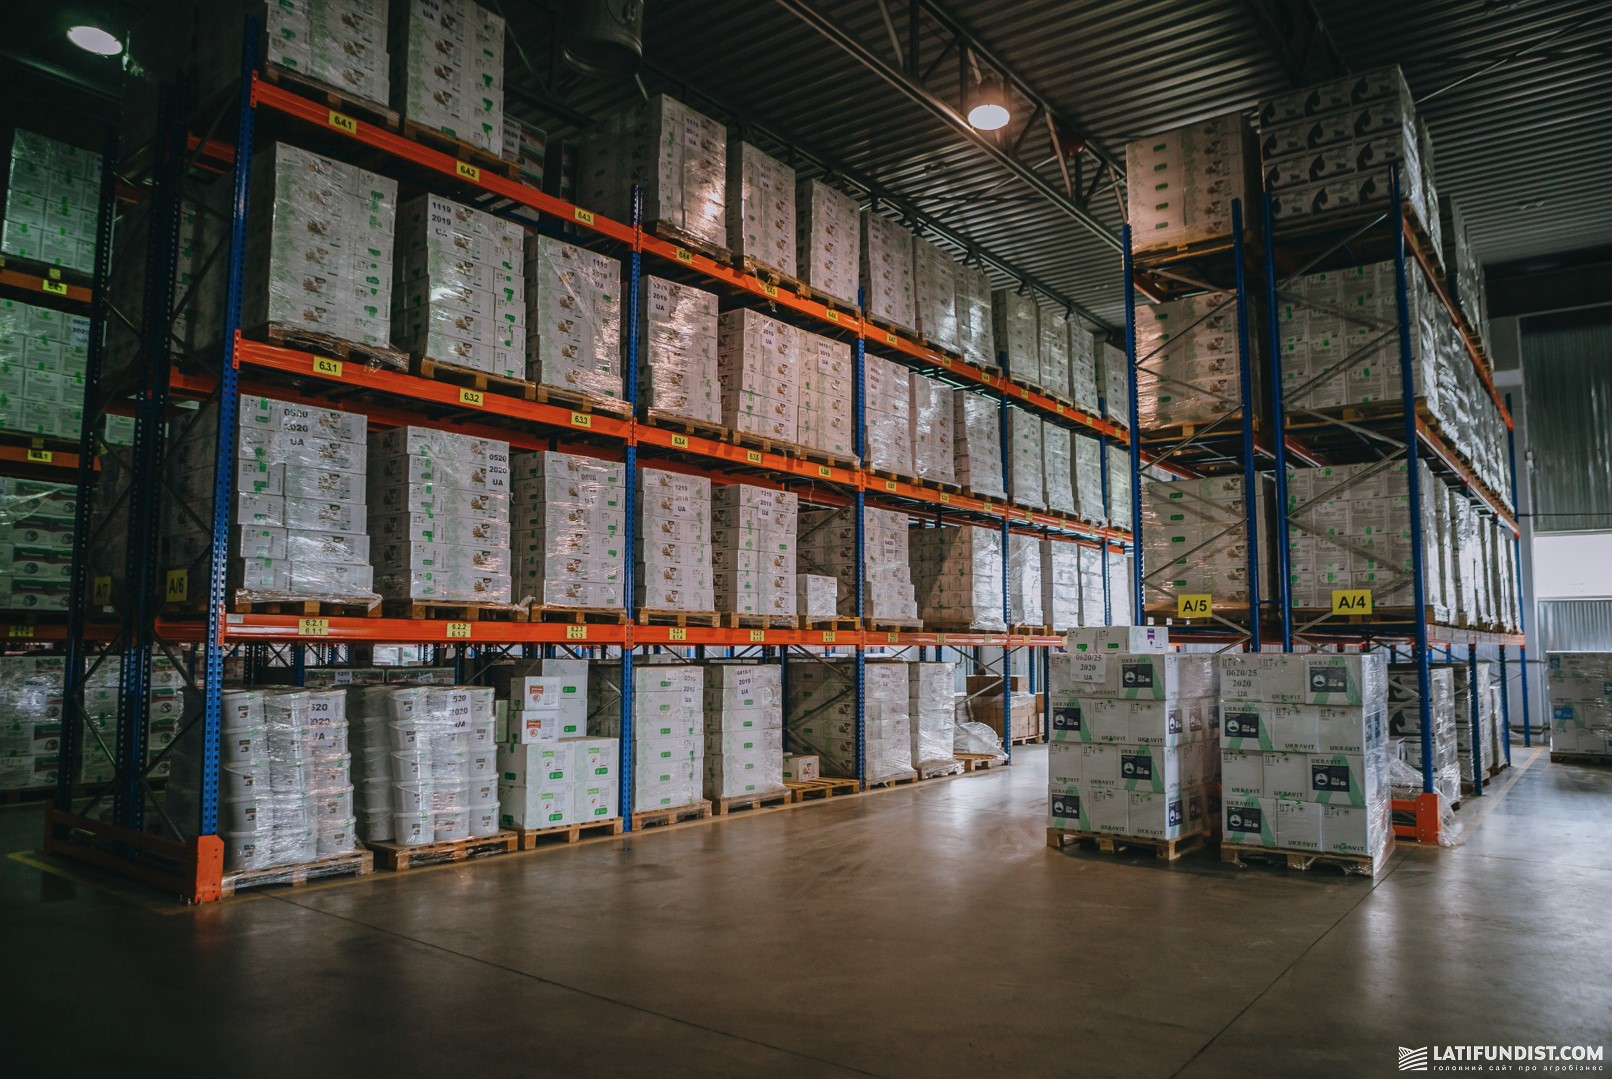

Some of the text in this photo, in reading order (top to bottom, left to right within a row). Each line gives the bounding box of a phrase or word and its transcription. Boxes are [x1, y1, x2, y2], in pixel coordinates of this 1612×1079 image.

[423, 10, 434, 20] UA
[335, 116, 352, 129] 6.4.1
[505, 140, 514, 148] UA
[689, 138, 697, 146] UA
[461, 165, 476, 177] 6.4.2
[432, 202, 451, 213] 1119
[432, 214, 451, 225] 2019
[578, 211, 591, 221] 6.4.3
[595, 281, 604, 289] UA
[653, 293, 667, 301] 2019
[320, 361, 337, 372] 6.3.1
[464, 392, 479, 402] 6.3.2
[284, 409, 308, 418] 0520
[575, 416, 588, 424] 6.3.3
[284, 423, 308, 432] 2020
[290, 438, 304, 446] UA
[489, 454, 507, 462] 0520
[489, 466, 507, 474] 2020
[493, 479, 503, 487] UA
[169, 578, 184, 593] A/6
[1183, 600, 1207, 612] A/5
[1339, 596, 1366, 609] A/4
[1226, 669, 1257, 677] 0620/25
